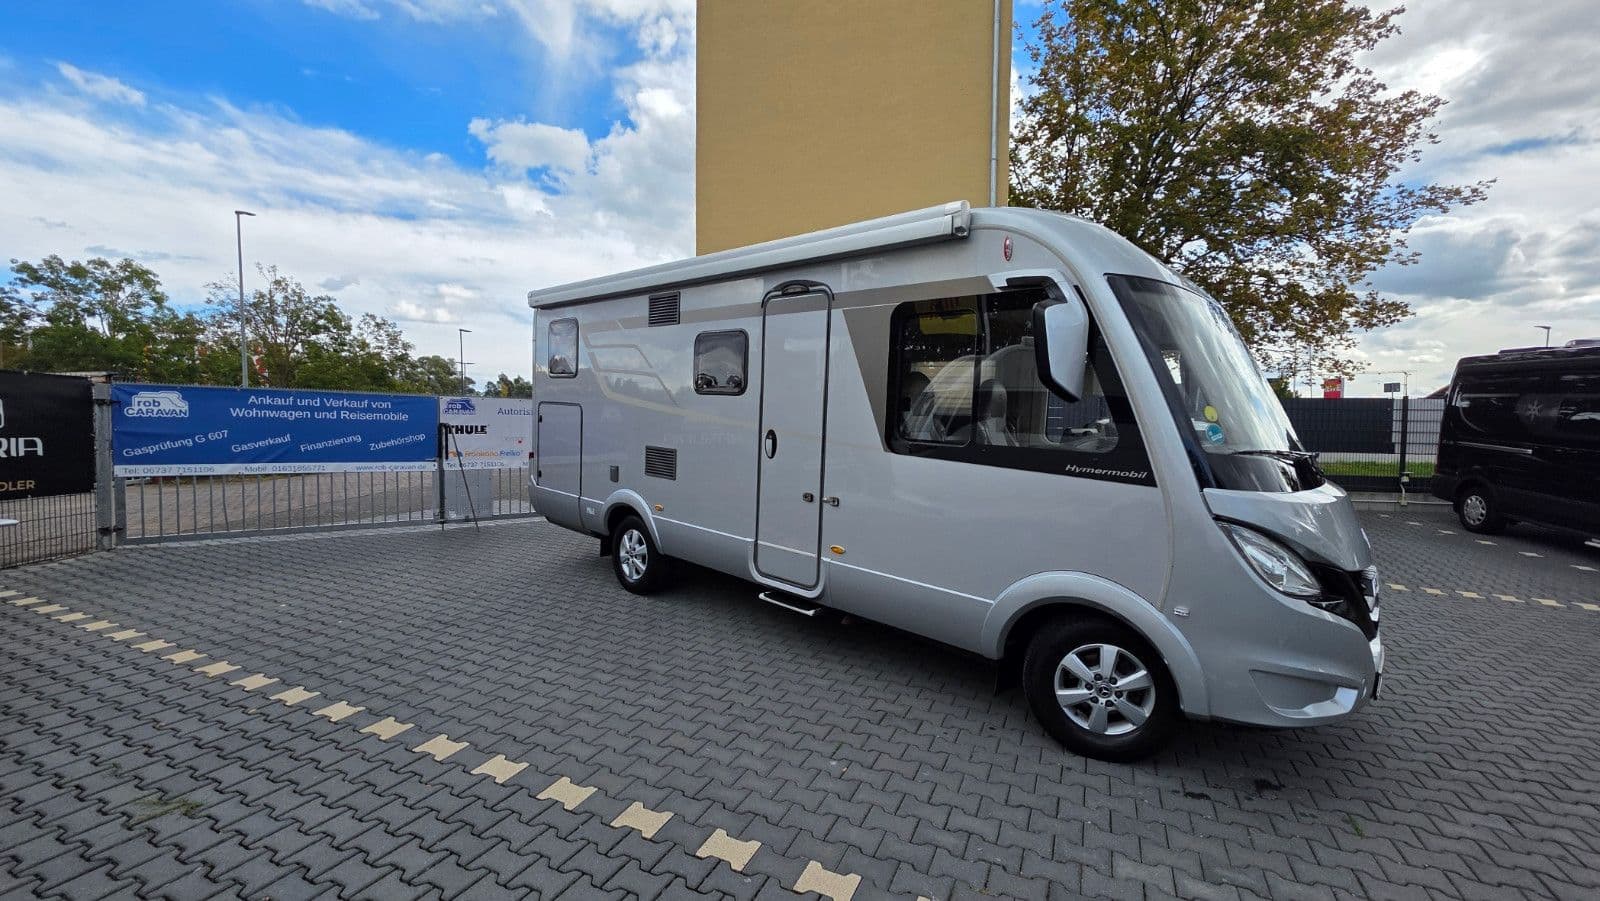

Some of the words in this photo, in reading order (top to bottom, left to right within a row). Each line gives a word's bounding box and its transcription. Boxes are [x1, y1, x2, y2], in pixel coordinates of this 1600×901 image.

[136, 399, 161, 408] rob
[248, 395, 294, 406] Ankauf
[297, 397, 320, 407] und
[324, 398, 368, 409] Verkauf
[371, 401, 392, 409] von
[125, 407, 188, 417] CARAVAN
[230, 408, 311, 421] Wohnwagen
[315, 411, 337, 420] und
[340, 410, 409, 422] Reisemobile
[448, 425, 487, 435] THULE
[123, 438, 192, 457] Gasprüfung
[195, 434, 206, 443] G
[208, 429, 229, 441] 607
[231, 433, 292, 453] Gasverkauf
[300, 433, 362, 453] Finanzierung
[1065, 464, 1148, 478] Hymermobil
[0, 480, 36, 492] DLER
